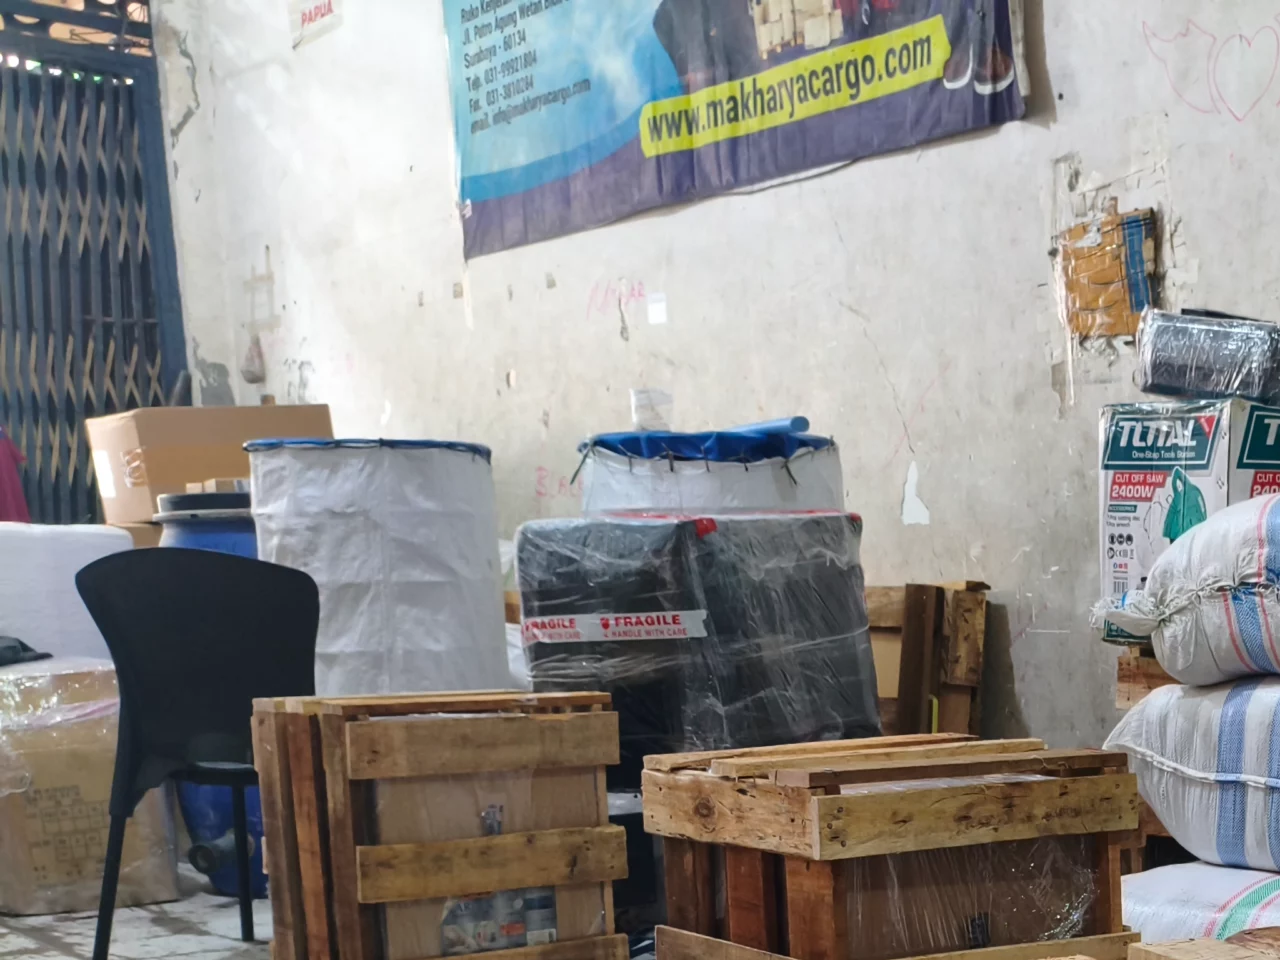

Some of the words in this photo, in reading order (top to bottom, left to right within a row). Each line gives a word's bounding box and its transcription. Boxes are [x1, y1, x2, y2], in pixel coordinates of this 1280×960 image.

[301, 0, 334, 28] PAPUA
[463, 44, 498, 69] Surabaya
[503, 27, 527, 52] 60134
[647, 34, 932, 143] www.makharyacargo.com
[1118, 419, 1198, 447] TOTAL
[1132, 450, 1160, 460] One-Stop
[1161, 451, 1175, 459] Tools
[1115, 473, 1129, 483] CUT
[1131, 473, 1145, 483] OFF
[1146, 473, 1165, 483] SAW
[1256, 473, 1273, 482] CUT
[1112, 485, 1154, 498] 2400W
[614, 614, 682, 628] FRAGILE
[611, 629, 642, 638] HANDLE
[645, 628, 665, 637] WITH
[667, 627, 688, 637] CARE
